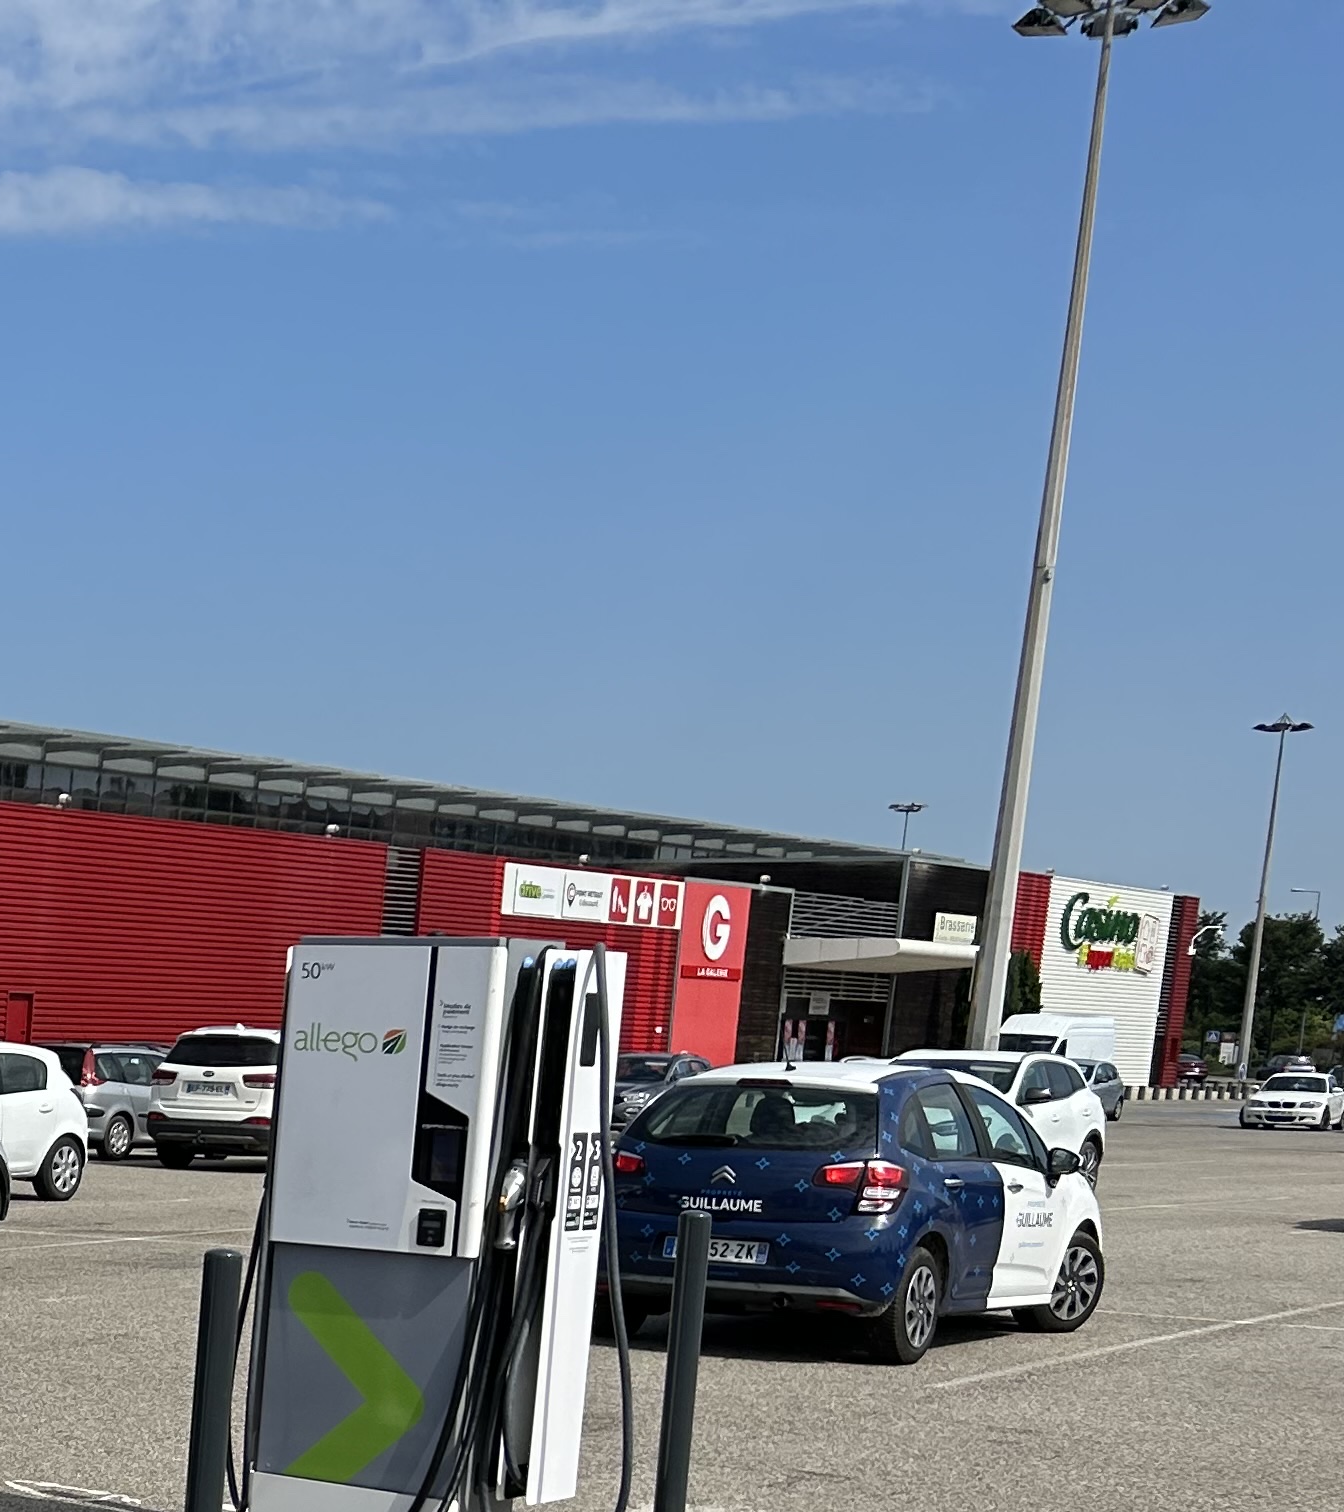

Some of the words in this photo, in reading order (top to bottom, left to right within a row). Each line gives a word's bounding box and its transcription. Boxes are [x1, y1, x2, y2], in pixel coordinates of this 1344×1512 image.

[702, 895, 731, 960] G
[1060, 892, 1141, 950] Casino
[697, 967, 705, 976] LA
[705, 967, 728, 977] GALERIE
[294, 1023, 378, 1062] allego
[575, 1140, 583, 1160] 2
[593, 1140, 601, 1160] 3
[680, 1196, 763, 1213] GUILLAUME
[709, 1241, 755, 1260] 52-ZK
